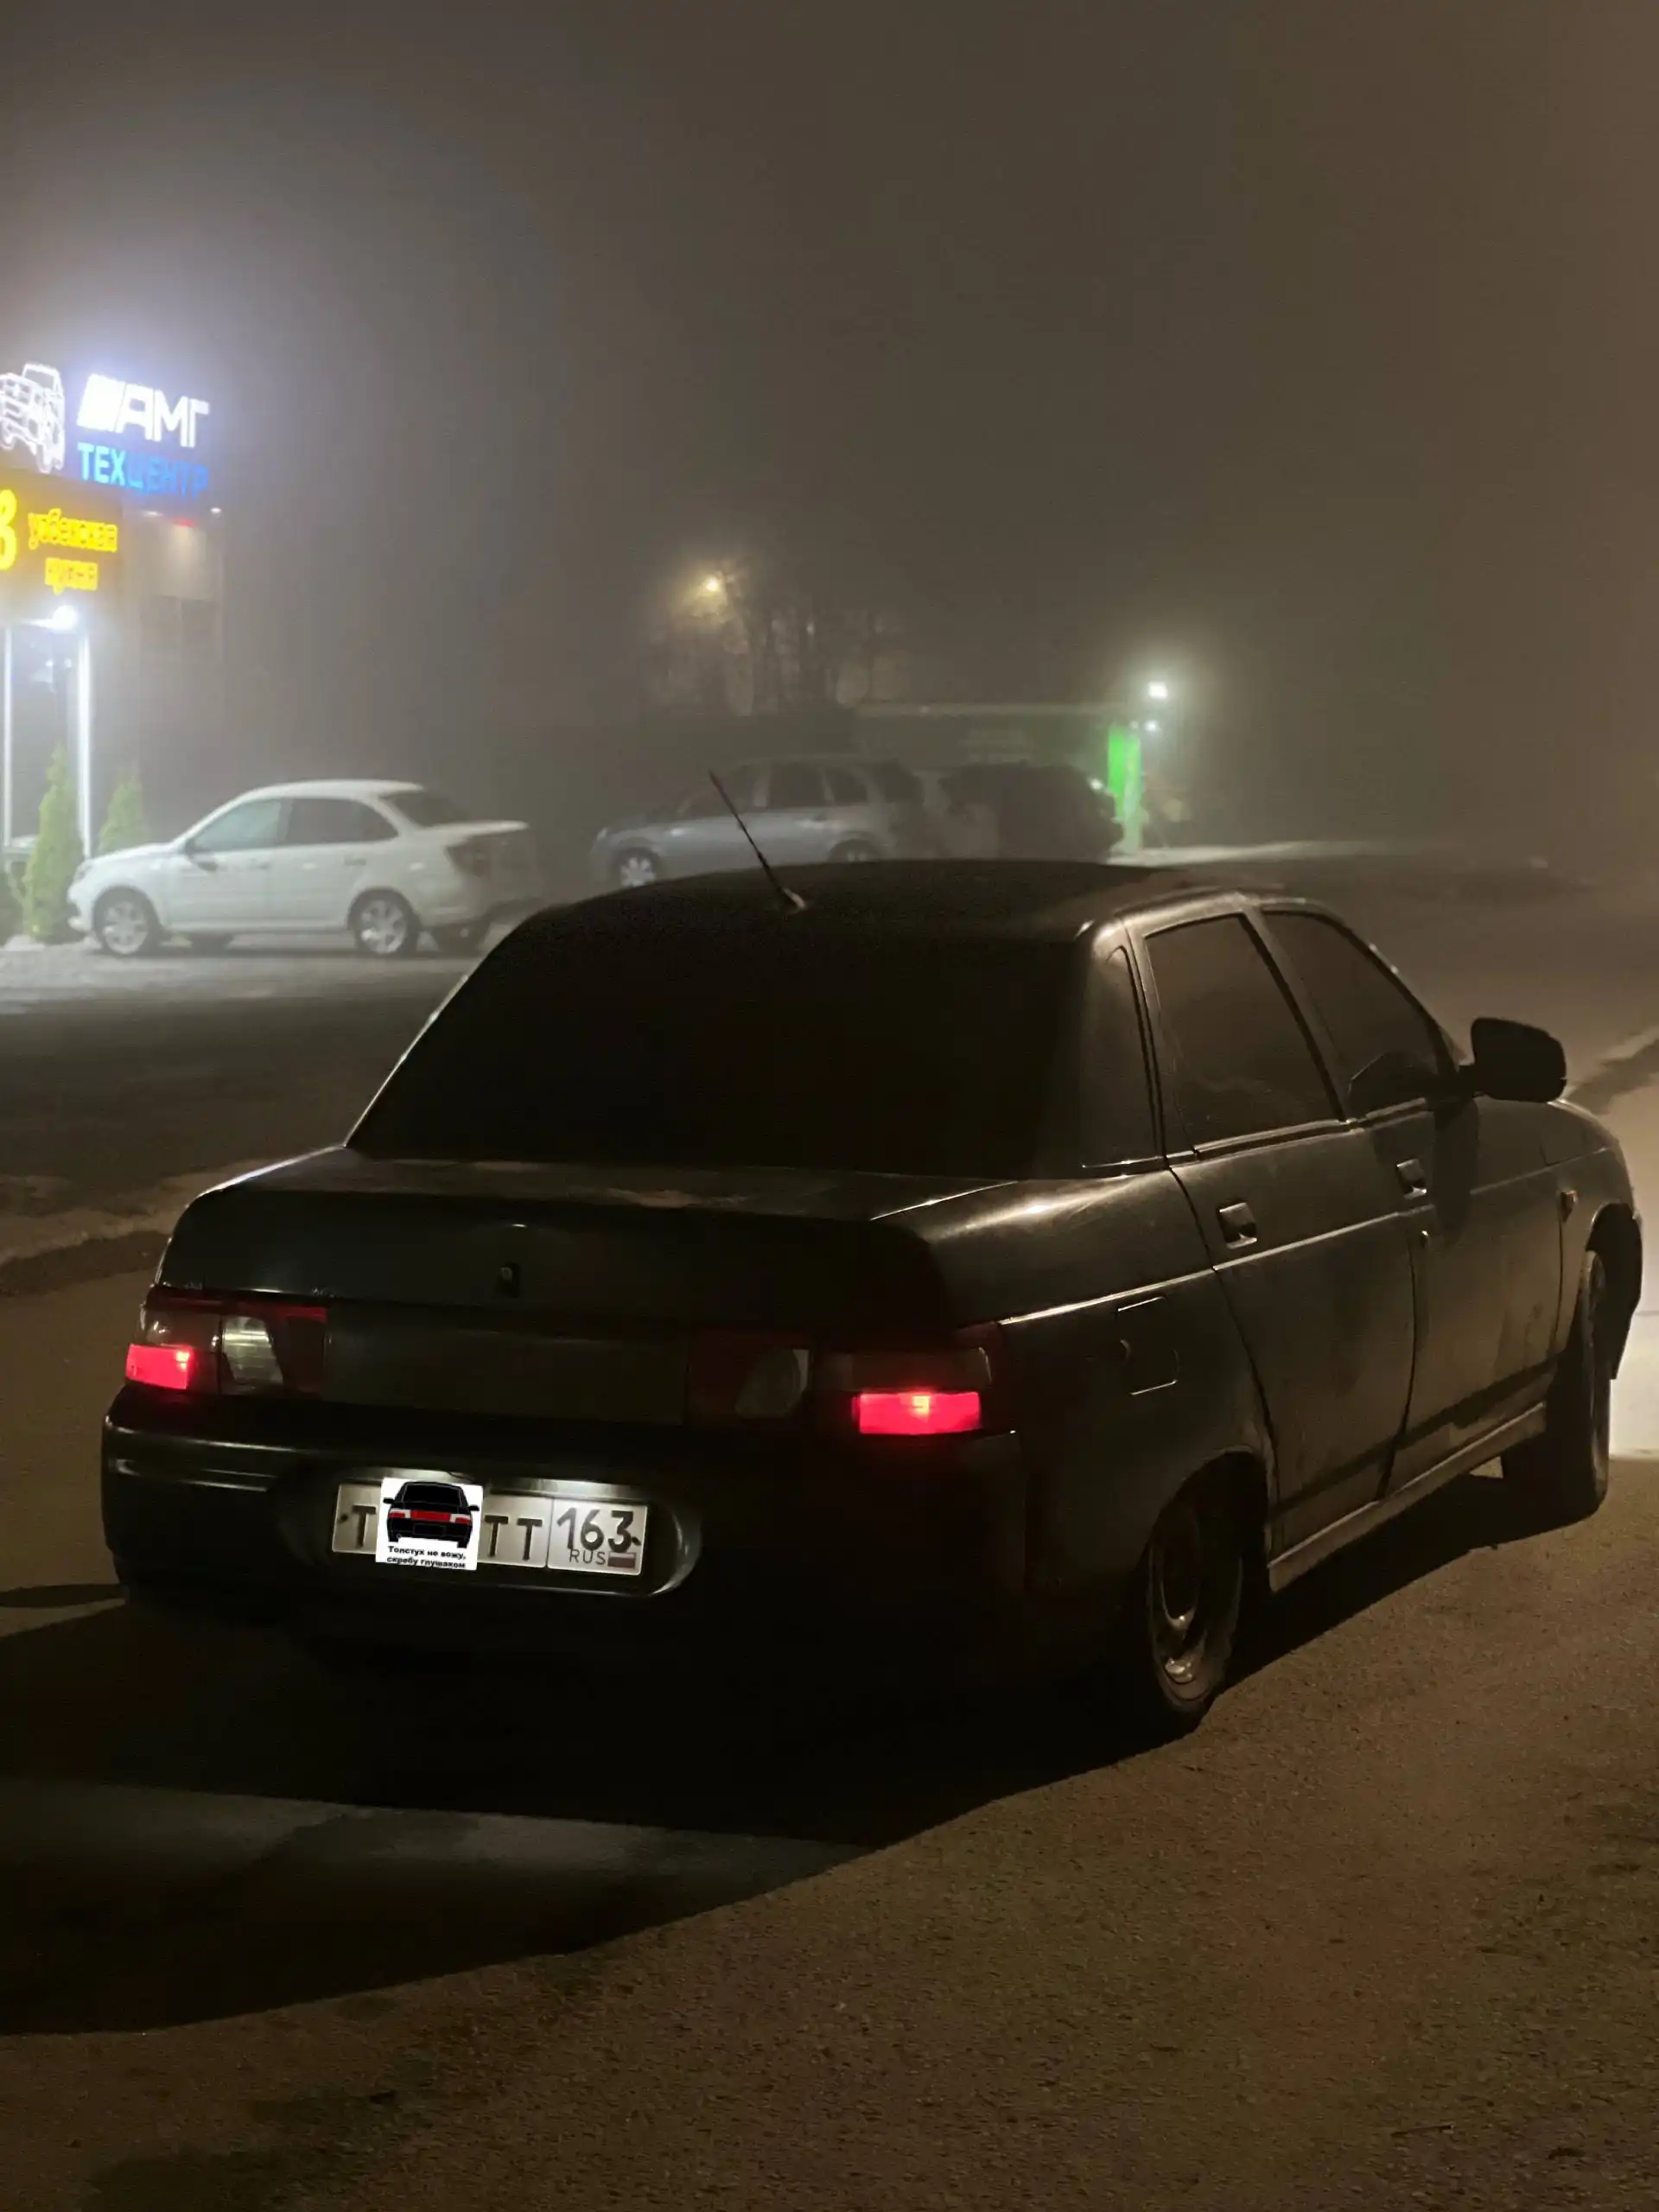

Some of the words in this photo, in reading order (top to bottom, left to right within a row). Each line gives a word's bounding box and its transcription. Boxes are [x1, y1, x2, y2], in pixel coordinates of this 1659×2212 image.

[77, 442, 210, 500] ТЕХЦЕНТР
[556, 1505, 634, 1554] 163
[569, 1548, 606, 1566] RUS
